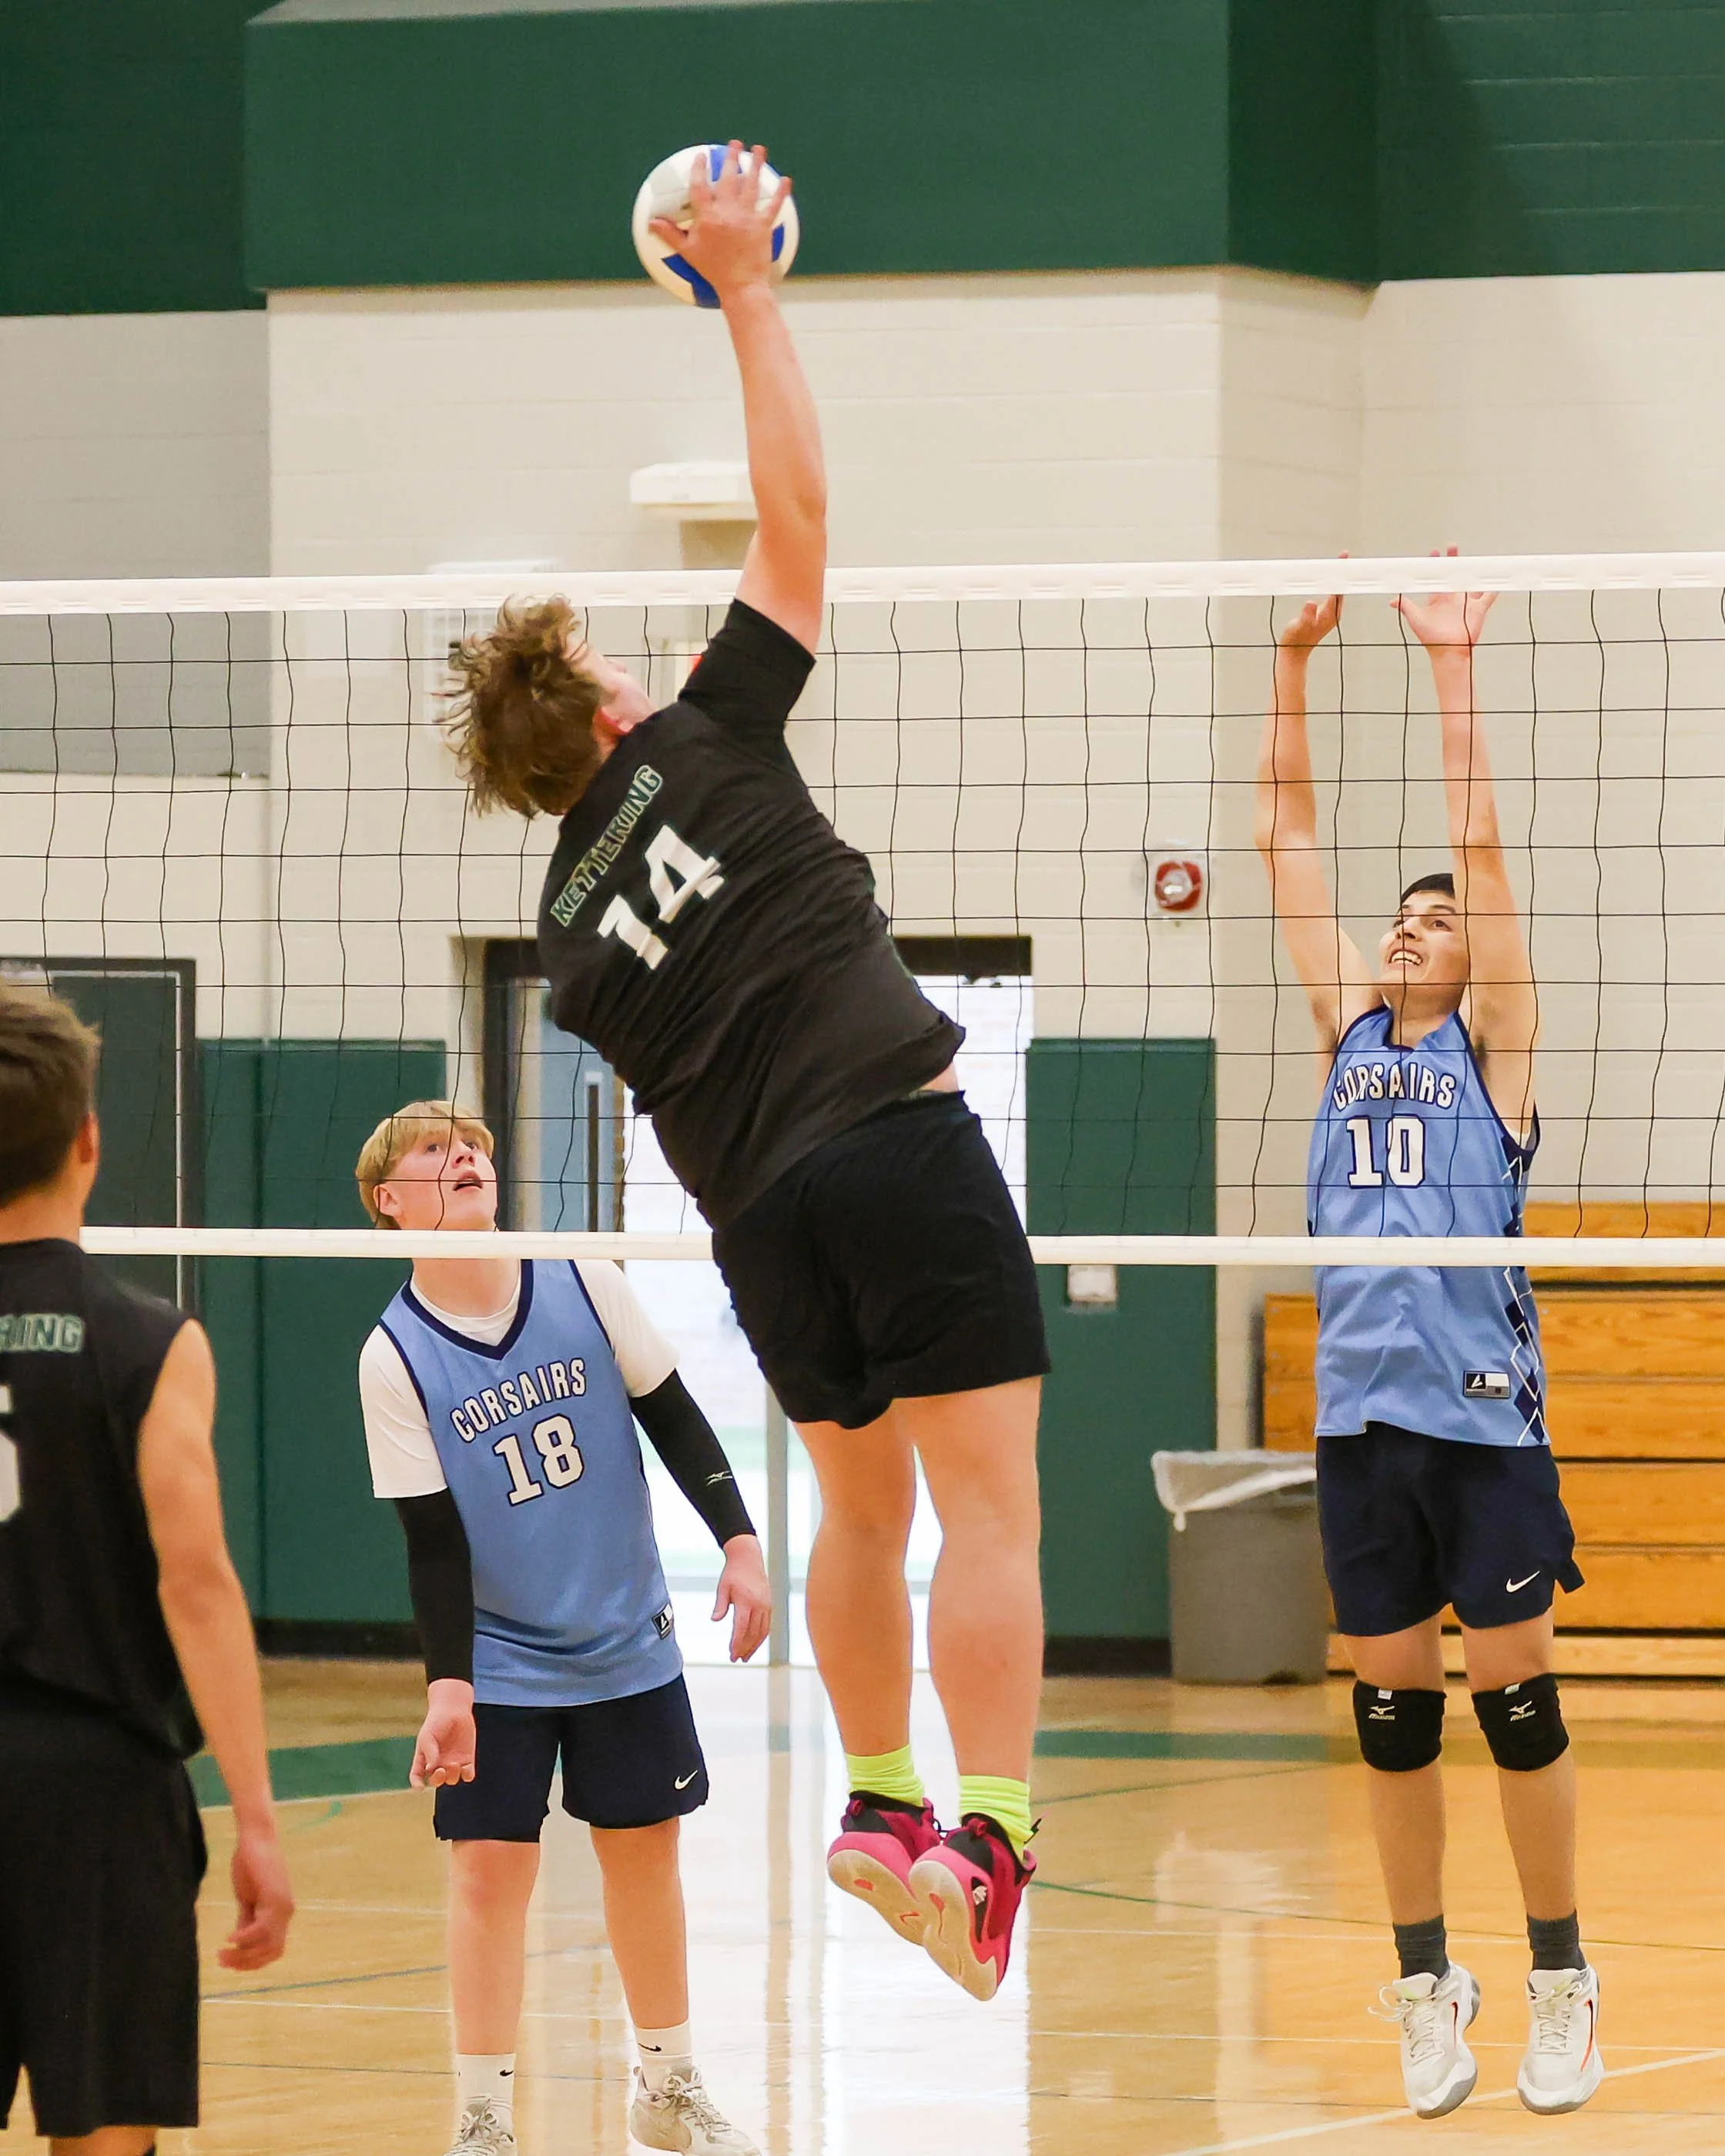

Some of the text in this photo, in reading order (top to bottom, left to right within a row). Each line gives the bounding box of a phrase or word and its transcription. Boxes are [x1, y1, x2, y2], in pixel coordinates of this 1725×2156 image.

[550, 764, 664, 927] KETTERING
[596, 824, 725, 971] 14
[1333, 1062, 1456, 1112] CORSAIRS
[1346, 1113, 1425, 1189] 10
[450, 1357, 587, 1443] CORSAIRS
[492, 1413, 584, 1507] 18
